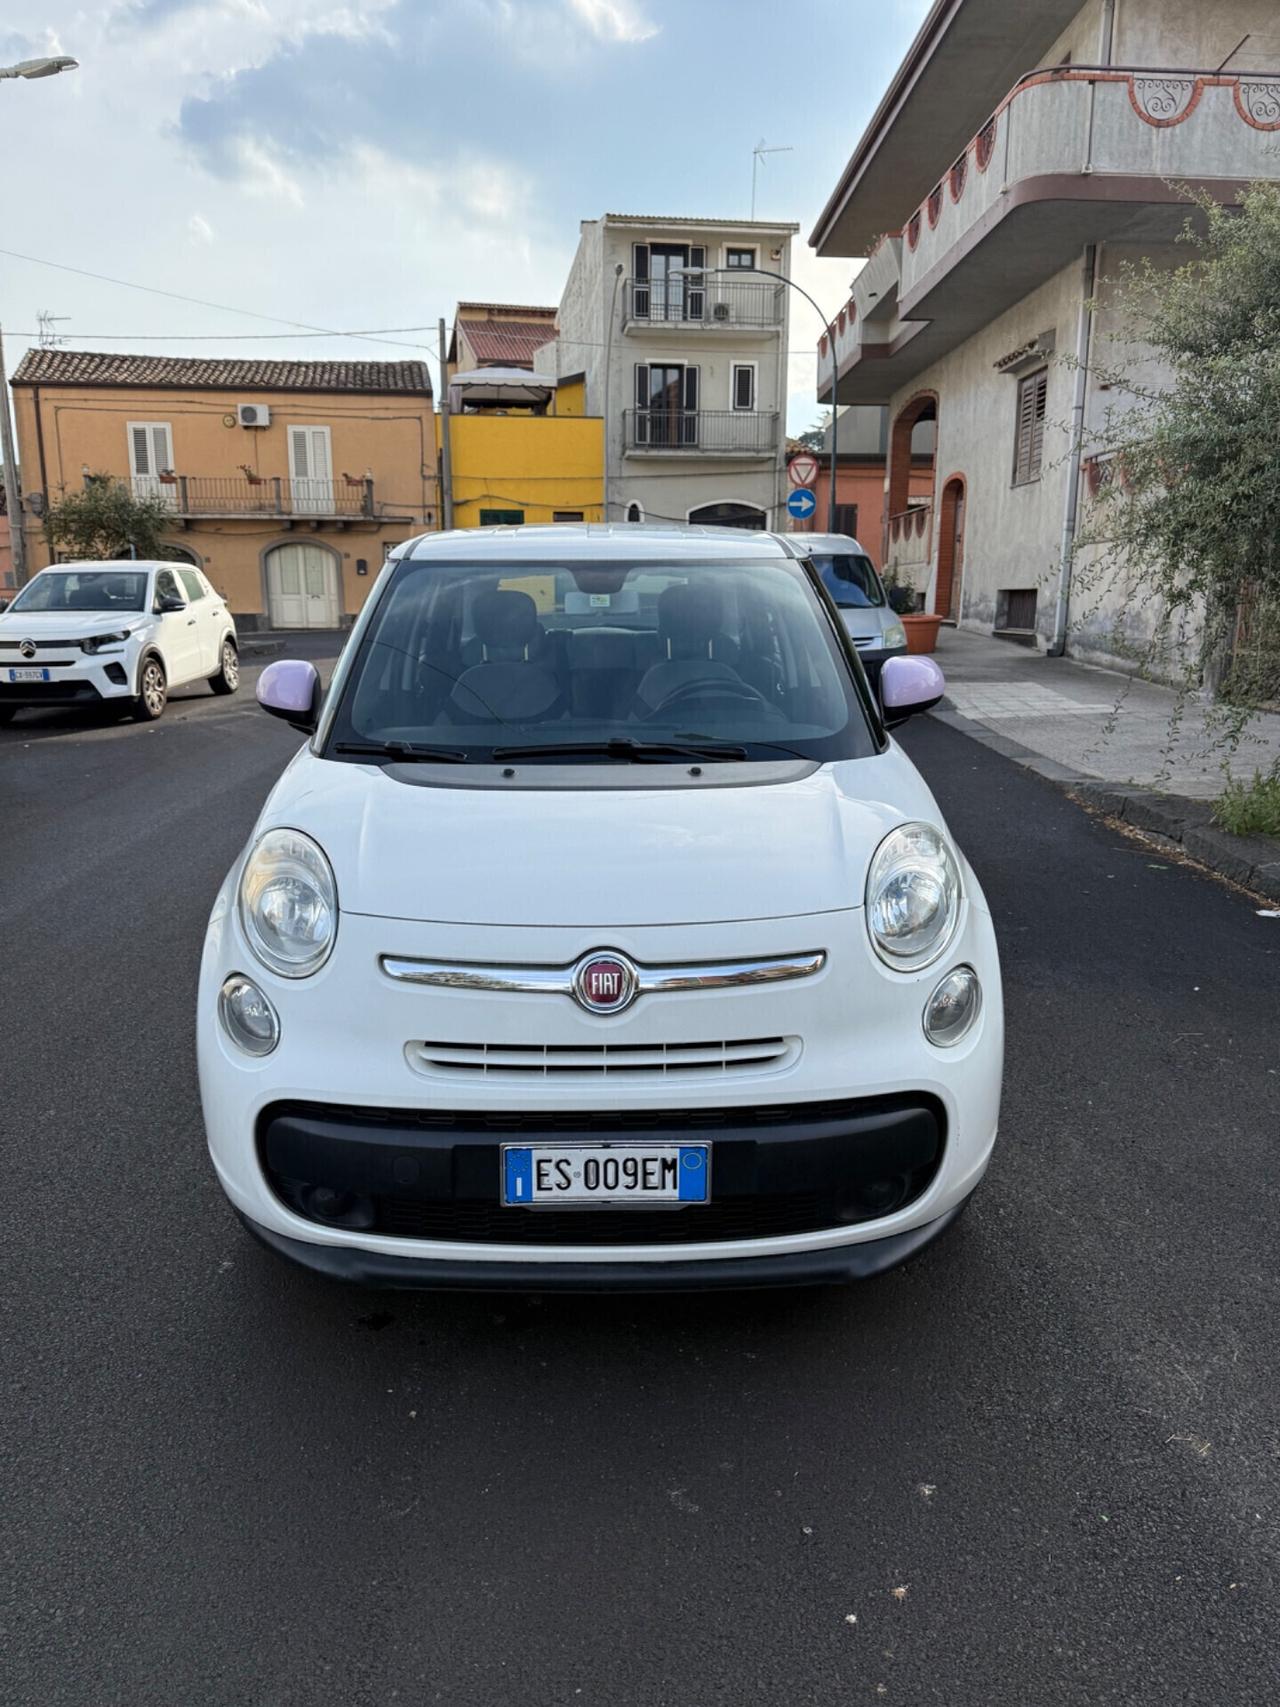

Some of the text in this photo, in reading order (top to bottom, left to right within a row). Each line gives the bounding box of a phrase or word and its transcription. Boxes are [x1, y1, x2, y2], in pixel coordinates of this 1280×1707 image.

[591, 973, 620, 995] FIAT
[516, 1157, 678, 1197] I ES 009EM
